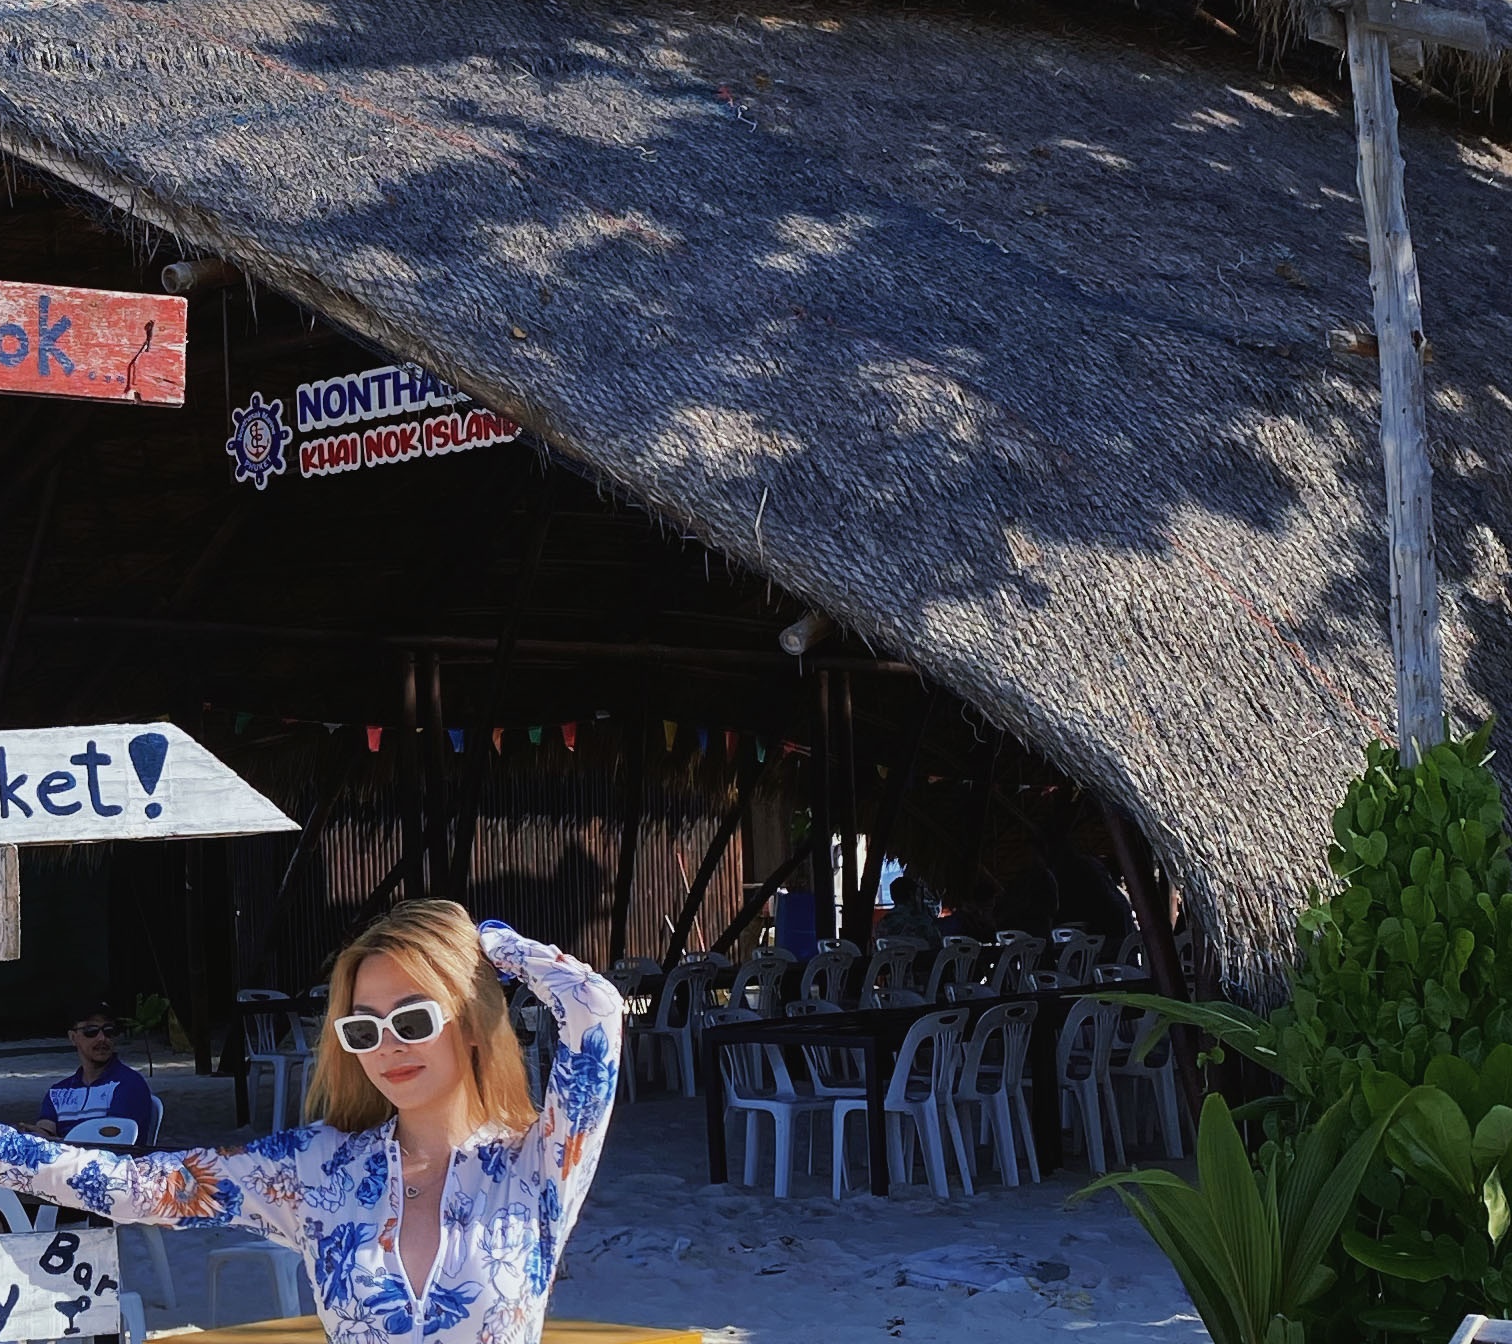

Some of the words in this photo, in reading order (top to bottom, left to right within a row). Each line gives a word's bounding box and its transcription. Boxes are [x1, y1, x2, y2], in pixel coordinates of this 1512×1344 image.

[299, 367, 450, 425] NONTHA
[301, 438, 359, 474] KHAI
[364, 426, 419, 462] NOK
[38, 1231, 119, 1297] Bar
